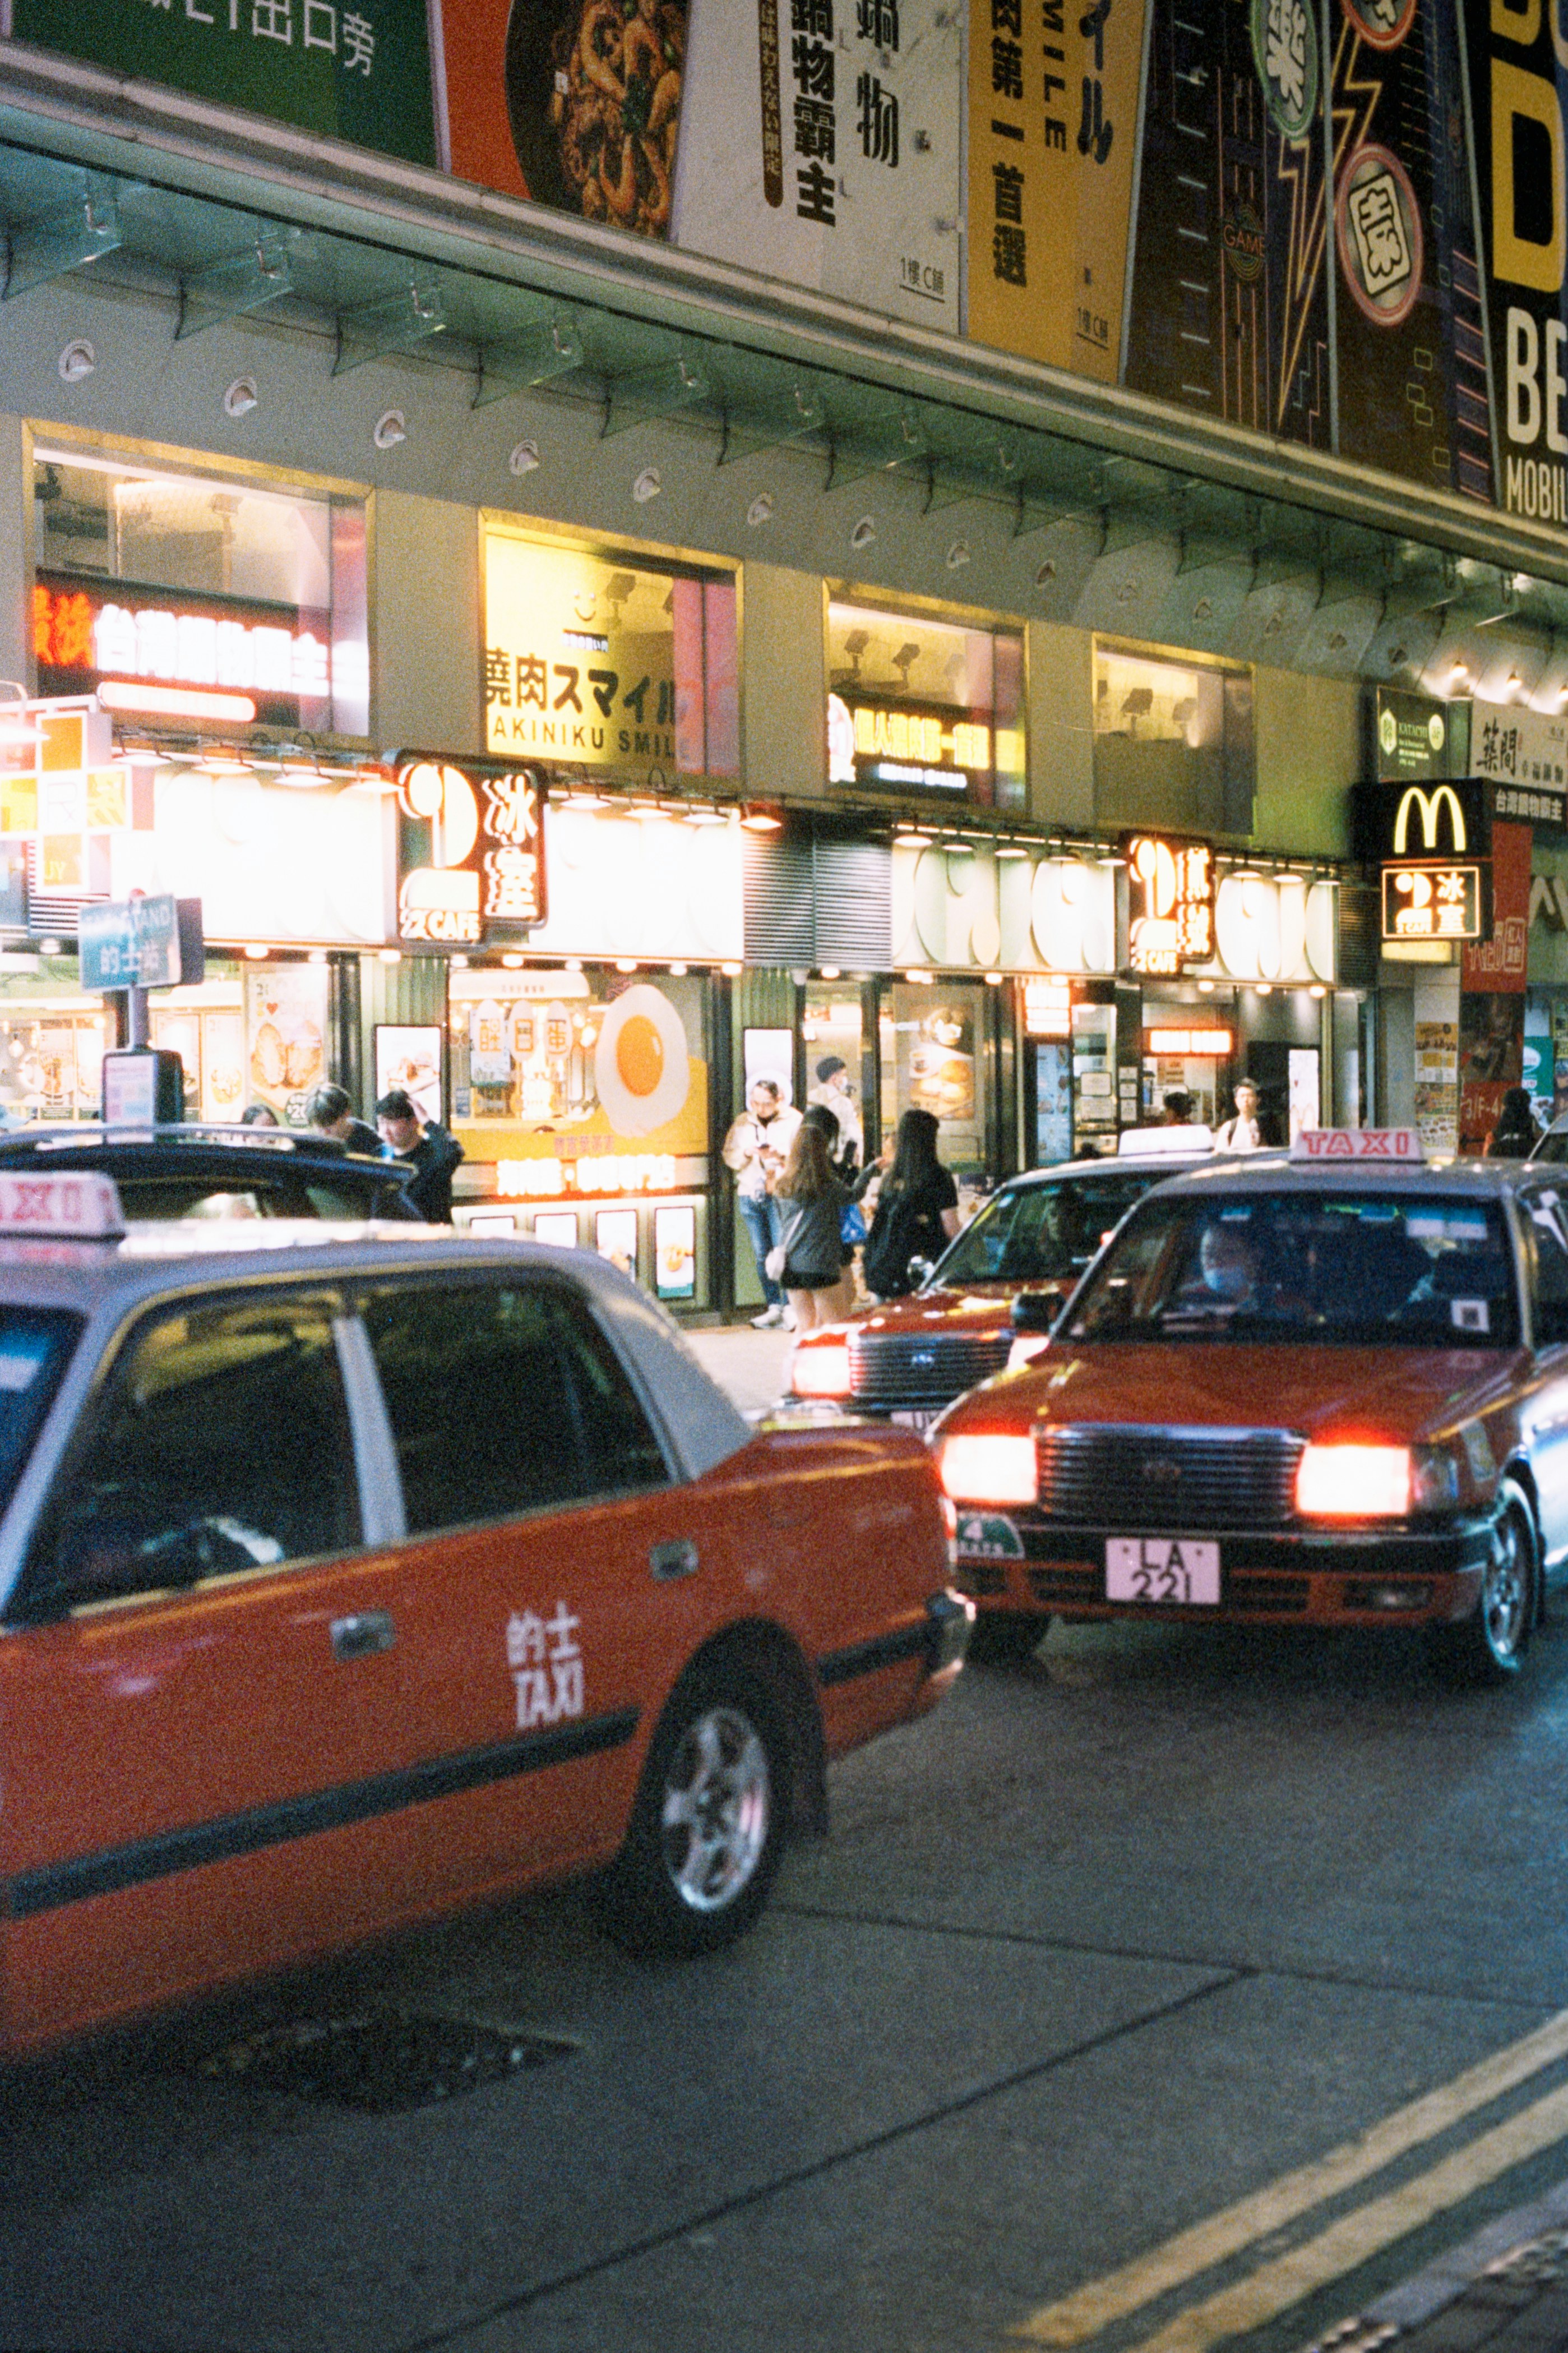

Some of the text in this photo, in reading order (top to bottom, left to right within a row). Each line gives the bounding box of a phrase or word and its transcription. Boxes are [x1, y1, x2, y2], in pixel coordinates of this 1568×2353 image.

[1302, 1131, 1409, 1155] TAXI
[0, 1180, 82, 1223] XI
[1140, 1540, 1187, 1570] LA
[1131, 1570, 1191, 1602] 221
